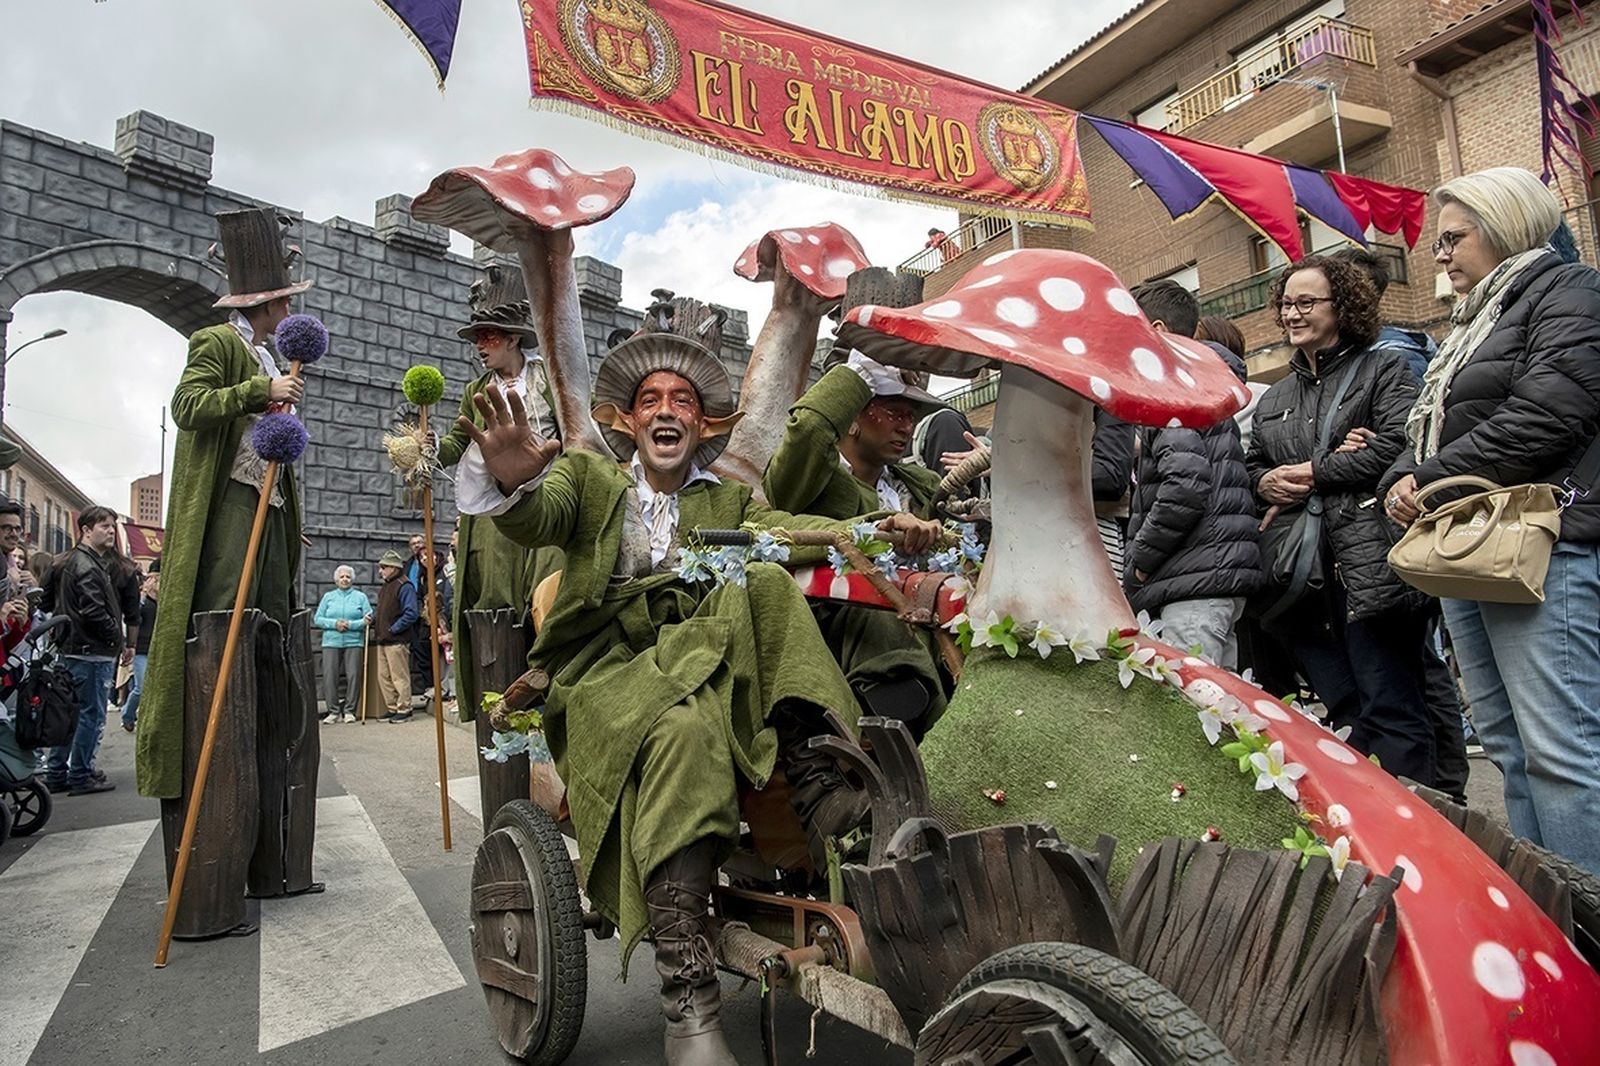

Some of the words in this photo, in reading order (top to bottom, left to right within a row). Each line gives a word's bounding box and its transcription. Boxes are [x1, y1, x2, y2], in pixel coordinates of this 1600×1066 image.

[690, 50, 765, 136] EL
[784, 78, 977, 182] ALAMO
[719, 30, 805, 76] FERIA
[811, 57, 941, 113] MEDIEVAL
